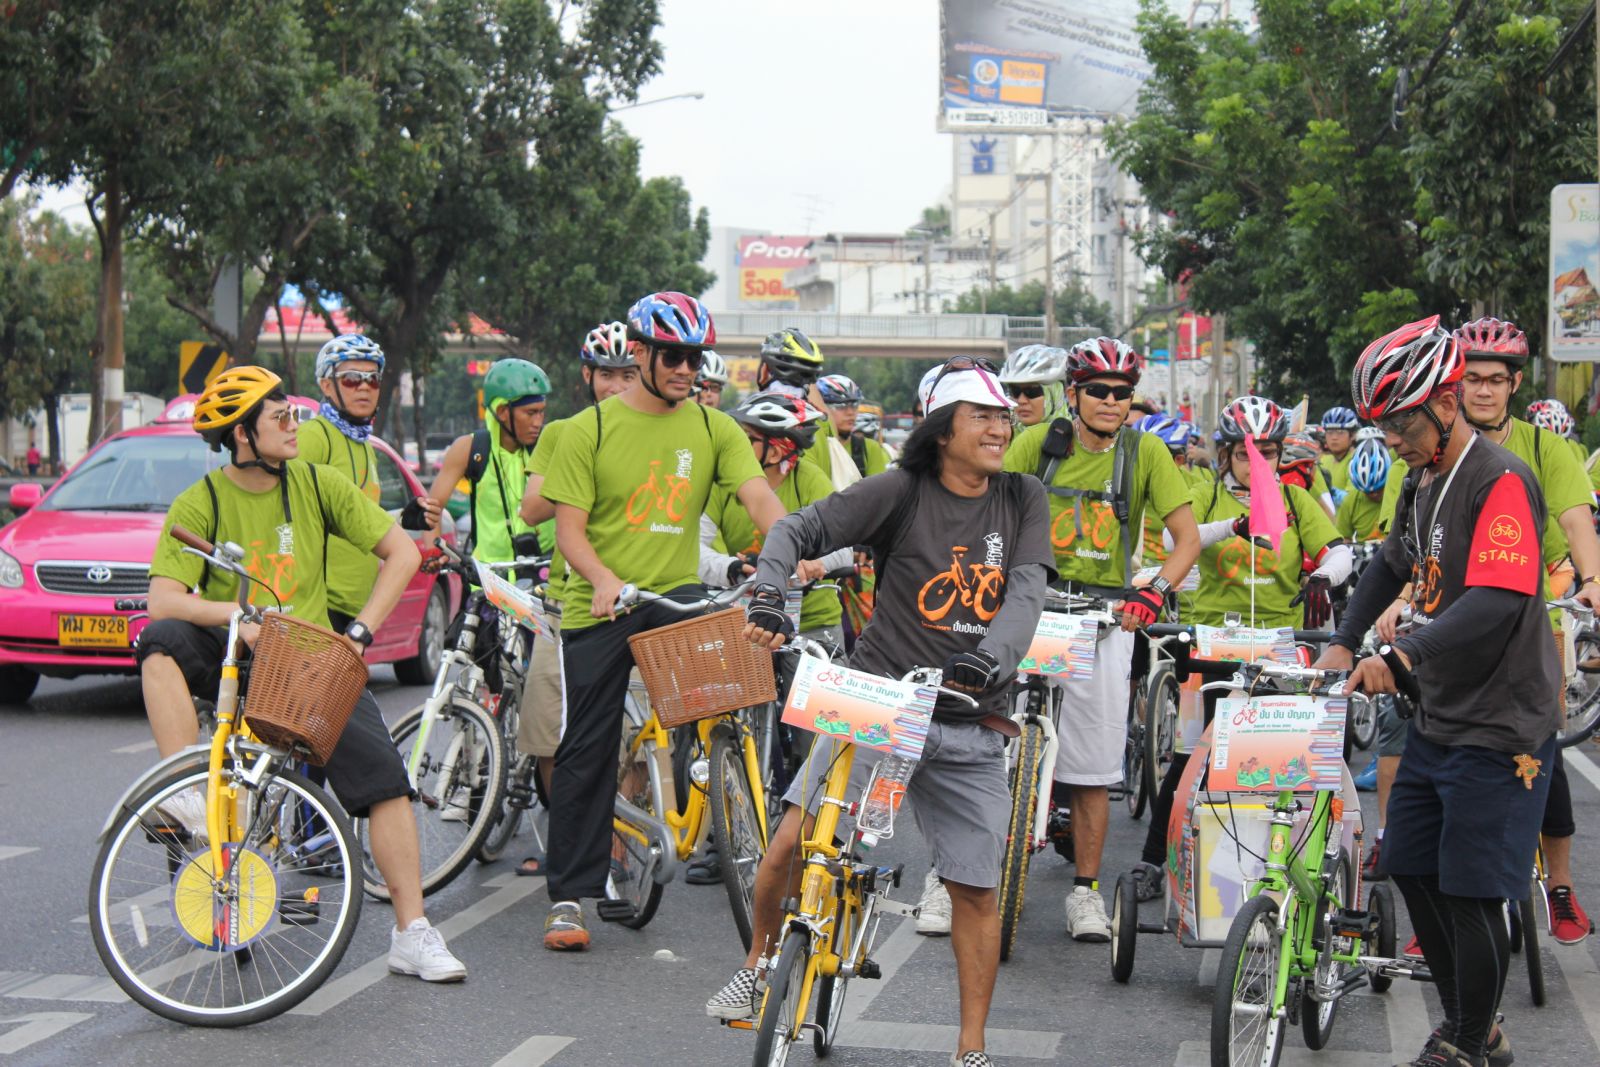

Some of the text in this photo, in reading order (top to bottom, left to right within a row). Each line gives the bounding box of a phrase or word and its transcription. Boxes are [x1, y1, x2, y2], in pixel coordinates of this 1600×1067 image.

[1478, 549, 1528, 566] STAFF
[89, 618, 125, 634] 7928
[1287, 709, 1315, 720] ปัญญา
